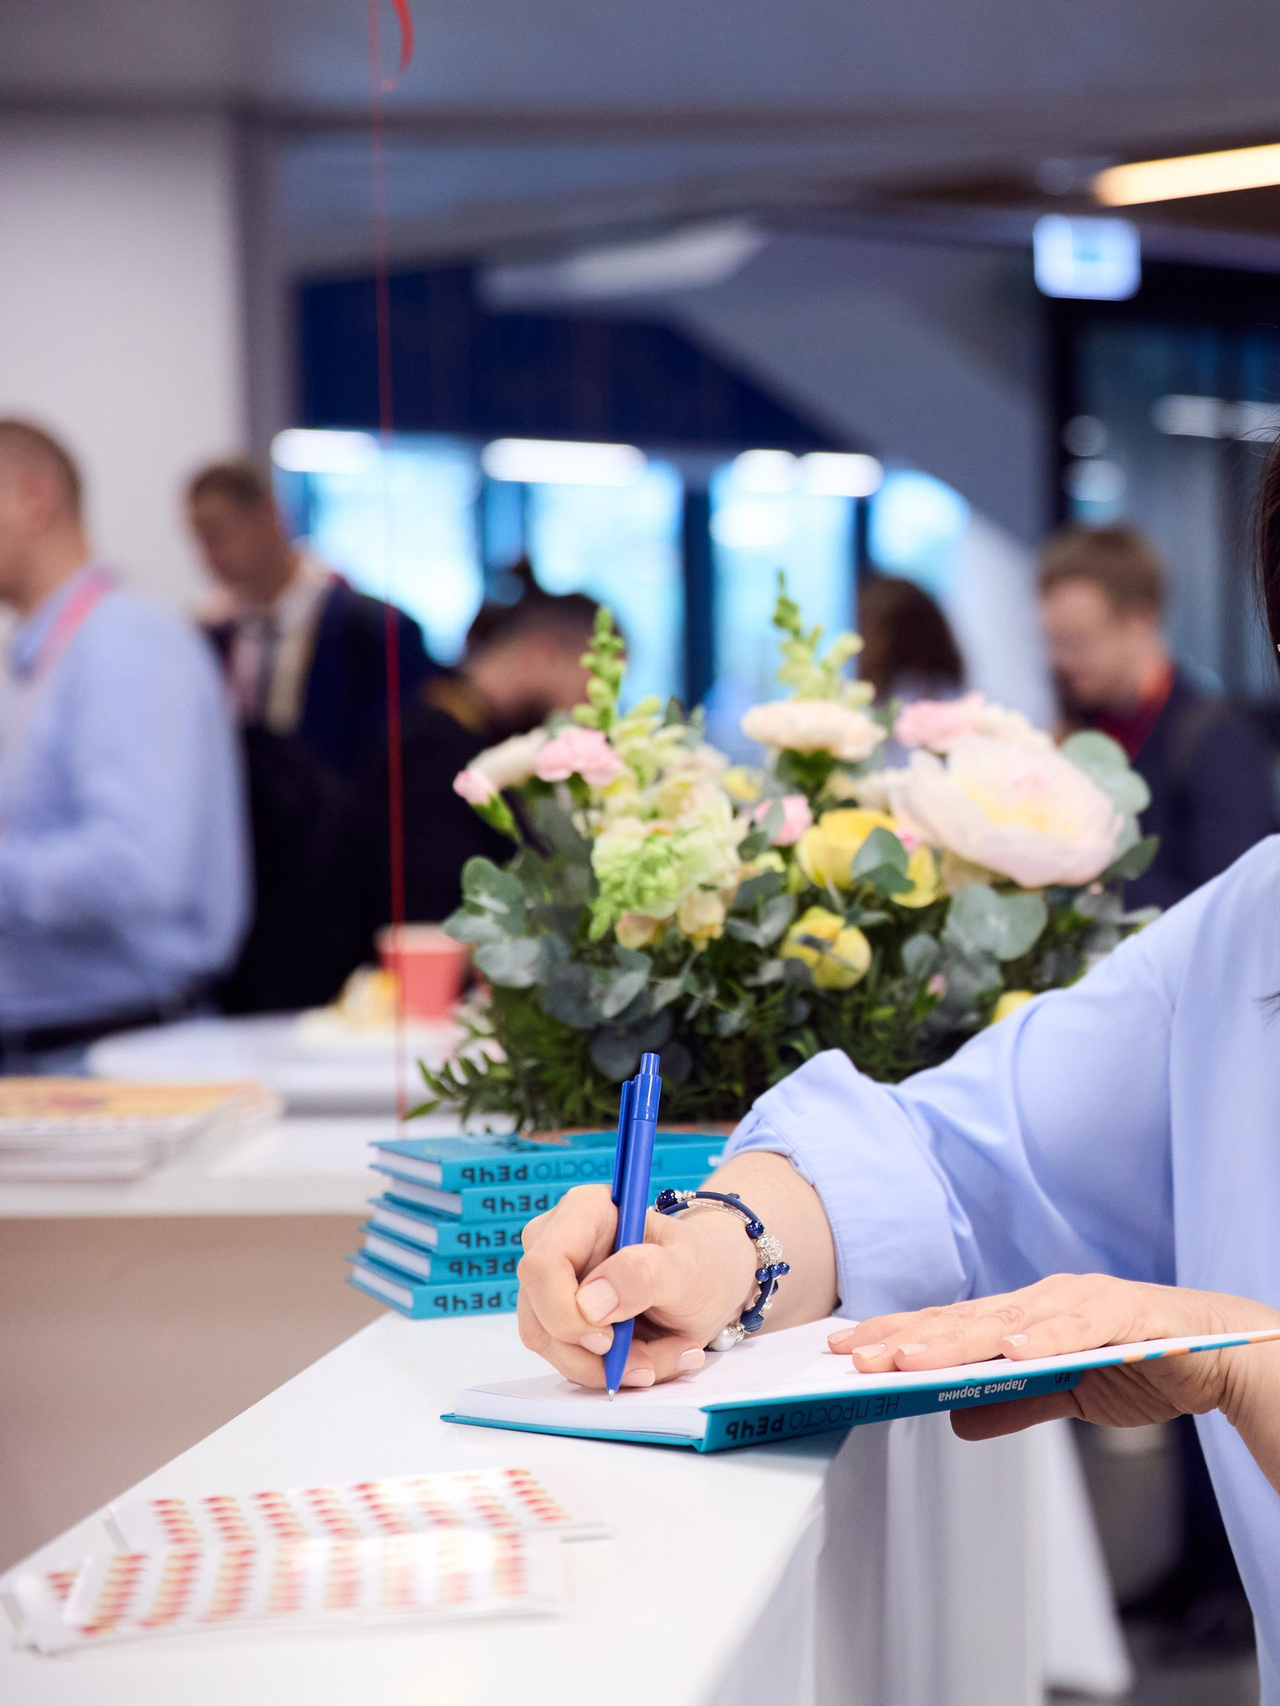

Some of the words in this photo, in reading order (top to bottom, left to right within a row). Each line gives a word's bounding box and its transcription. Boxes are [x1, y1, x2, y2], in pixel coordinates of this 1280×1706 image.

[461, 1165, 527, 1183] РЕЧЬ
[534, 1158, 609, 1180] РОСТО
[482, 1194, 548, 1214] РЕЧЬ
[456, 1230, 522, 1249] РЕЧЬ
[448, 1258, 516, 1277] РЕЧЬ
[433, 1292, 502, 1311] РЕЧЬ
[938, 1384, 982, 1402] Зорина
[984, 1378, 1027, 1394] Лариса
[789, 1400, 870, 1431] ПРОСТО
[873, 1395, 901, 1417] НЕ
[725, 1414, 785, 1441] РЕЧЬ
